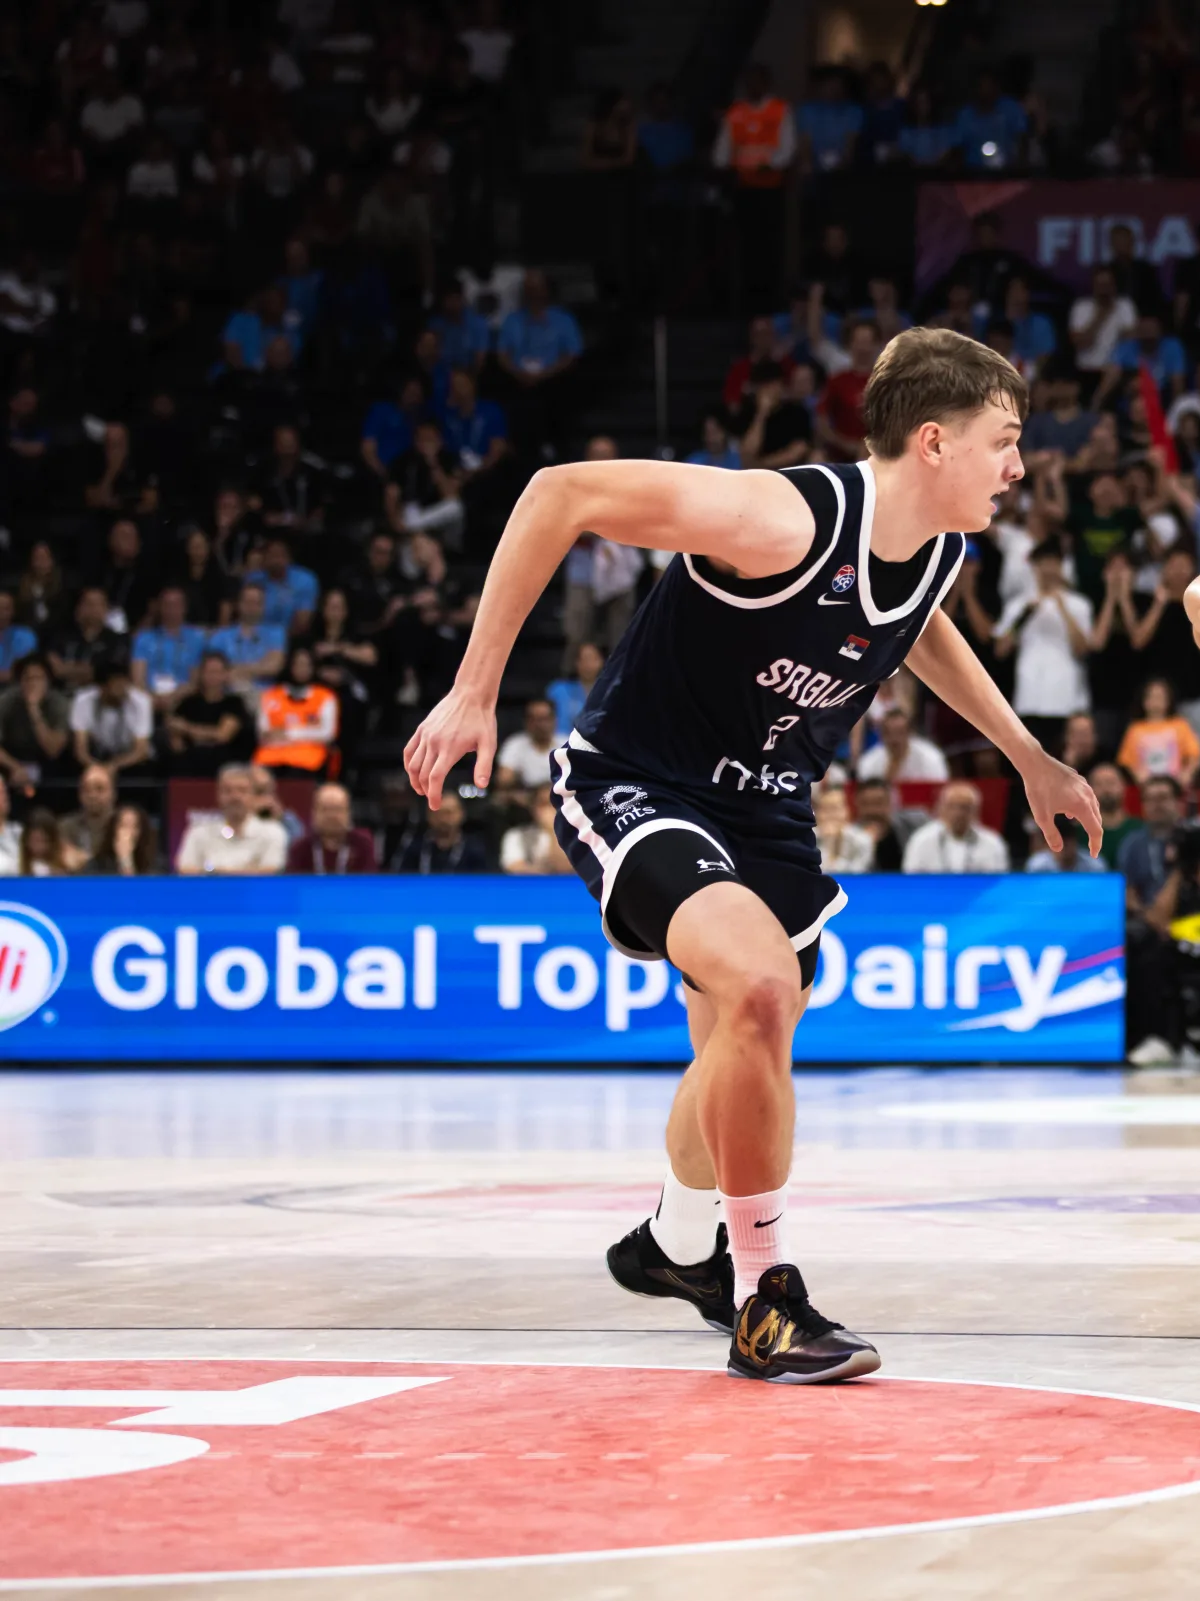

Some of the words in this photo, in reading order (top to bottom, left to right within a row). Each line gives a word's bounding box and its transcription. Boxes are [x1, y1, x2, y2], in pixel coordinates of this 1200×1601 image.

[762, 715, 800, 751] 2
[614, 806, 656, 832] mts
[91, 925, 438, 1011] Global
[473, 925, 688, 1032] Top
